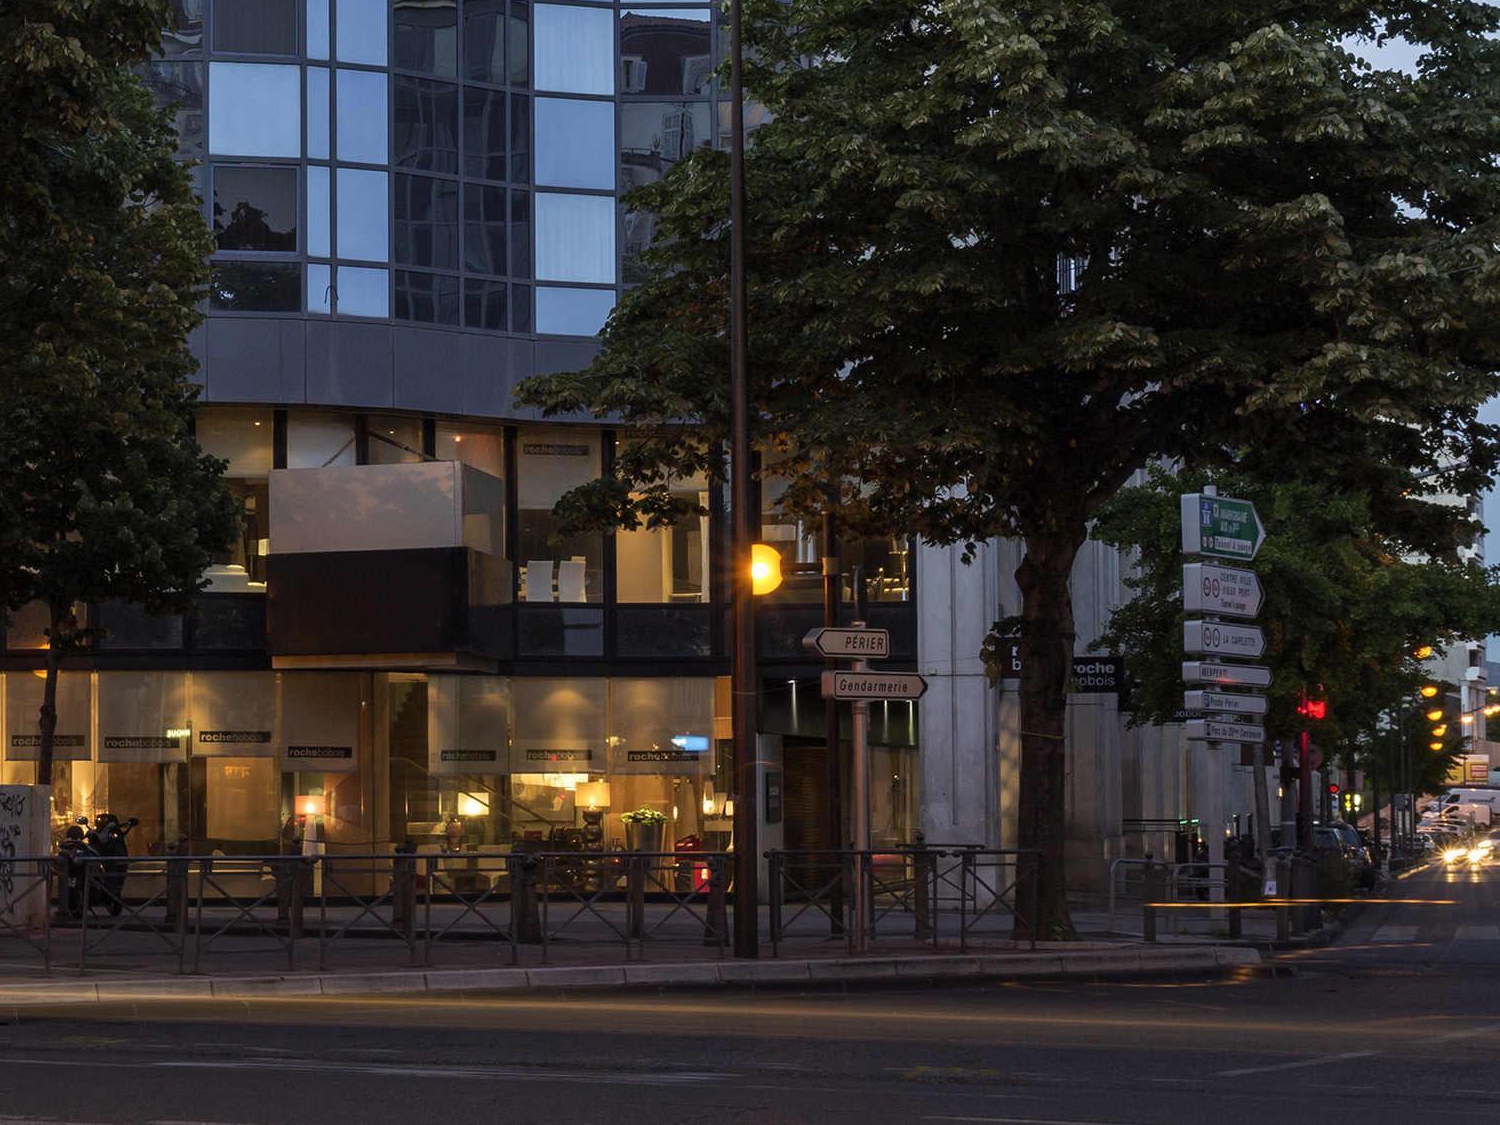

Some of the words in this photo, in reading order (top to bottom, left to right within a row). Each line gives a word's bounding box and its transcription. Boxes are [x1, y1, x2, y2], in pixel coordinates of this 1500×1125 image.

[844, 635, 884, 650] PÉRIER
[840, 678, 909, 693] Gendarmerie
[1076, 675, 1116, 686] obois
